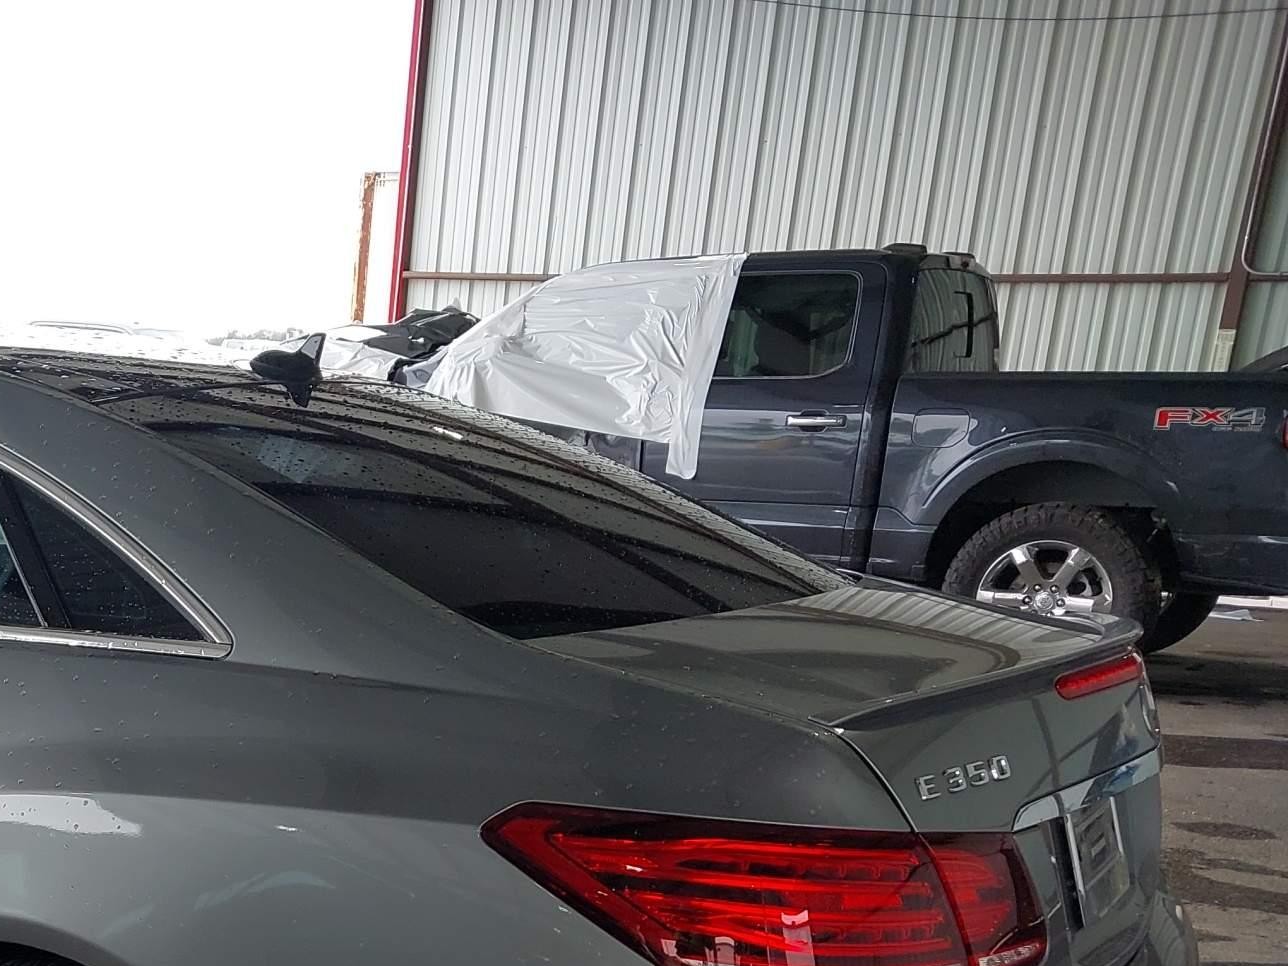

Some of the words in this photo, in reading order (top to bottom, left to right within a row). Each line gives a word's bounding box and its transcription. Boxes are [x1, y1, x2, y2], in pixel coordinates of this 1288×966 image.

[1153, 407, 1266, 431] FX4
[915, 774, 942, 801] E
[943, 755, 1011, 792] 350
